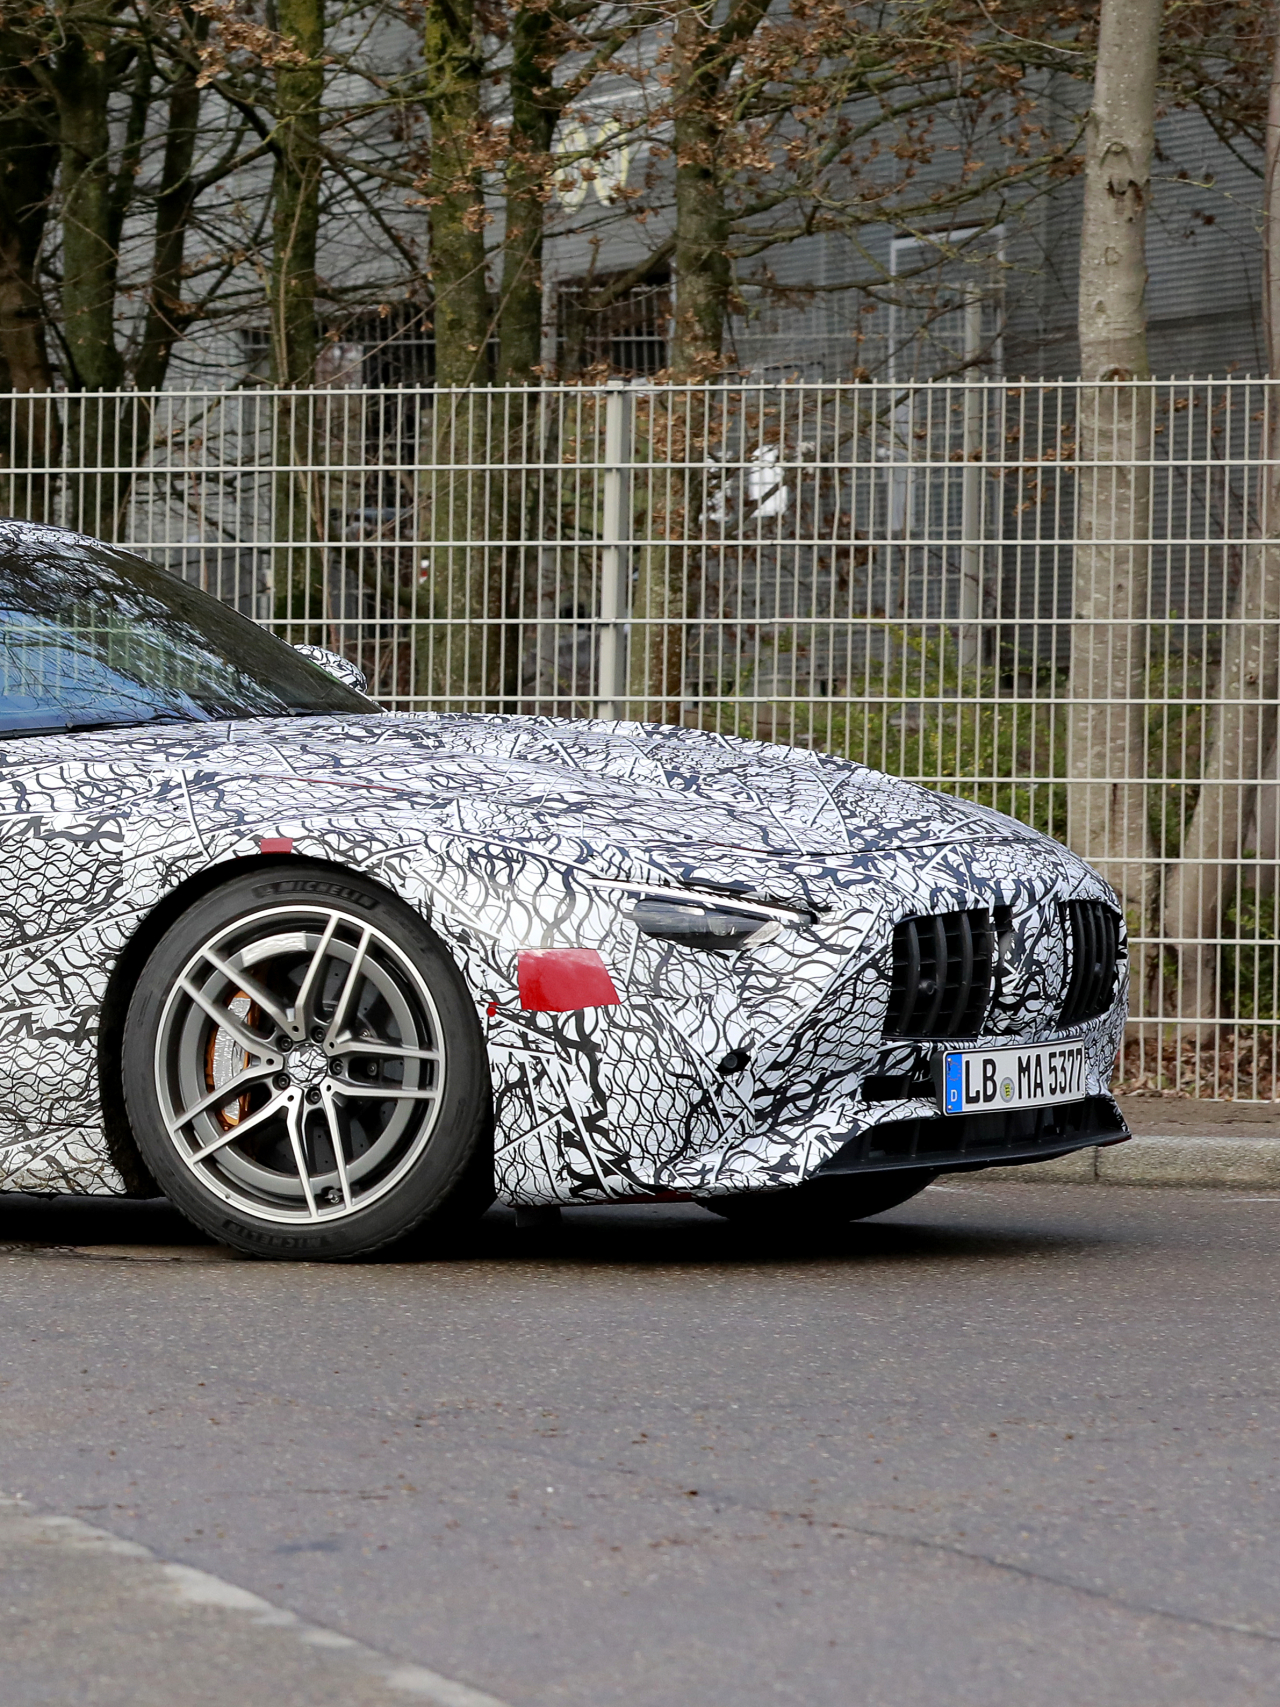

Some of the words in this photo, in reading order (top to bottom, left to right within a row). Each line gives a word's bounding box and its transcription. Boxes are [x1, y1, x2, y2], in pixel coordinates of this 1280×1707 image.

[278, 881, 374, 907] MICHELIN
[965, 1059, 997, 1104] LB
[1017, 1054, 1044, 1100] MA
[1049, 1048, 1082, 1095] 5377
[950, 1089, 958, 1102] D
